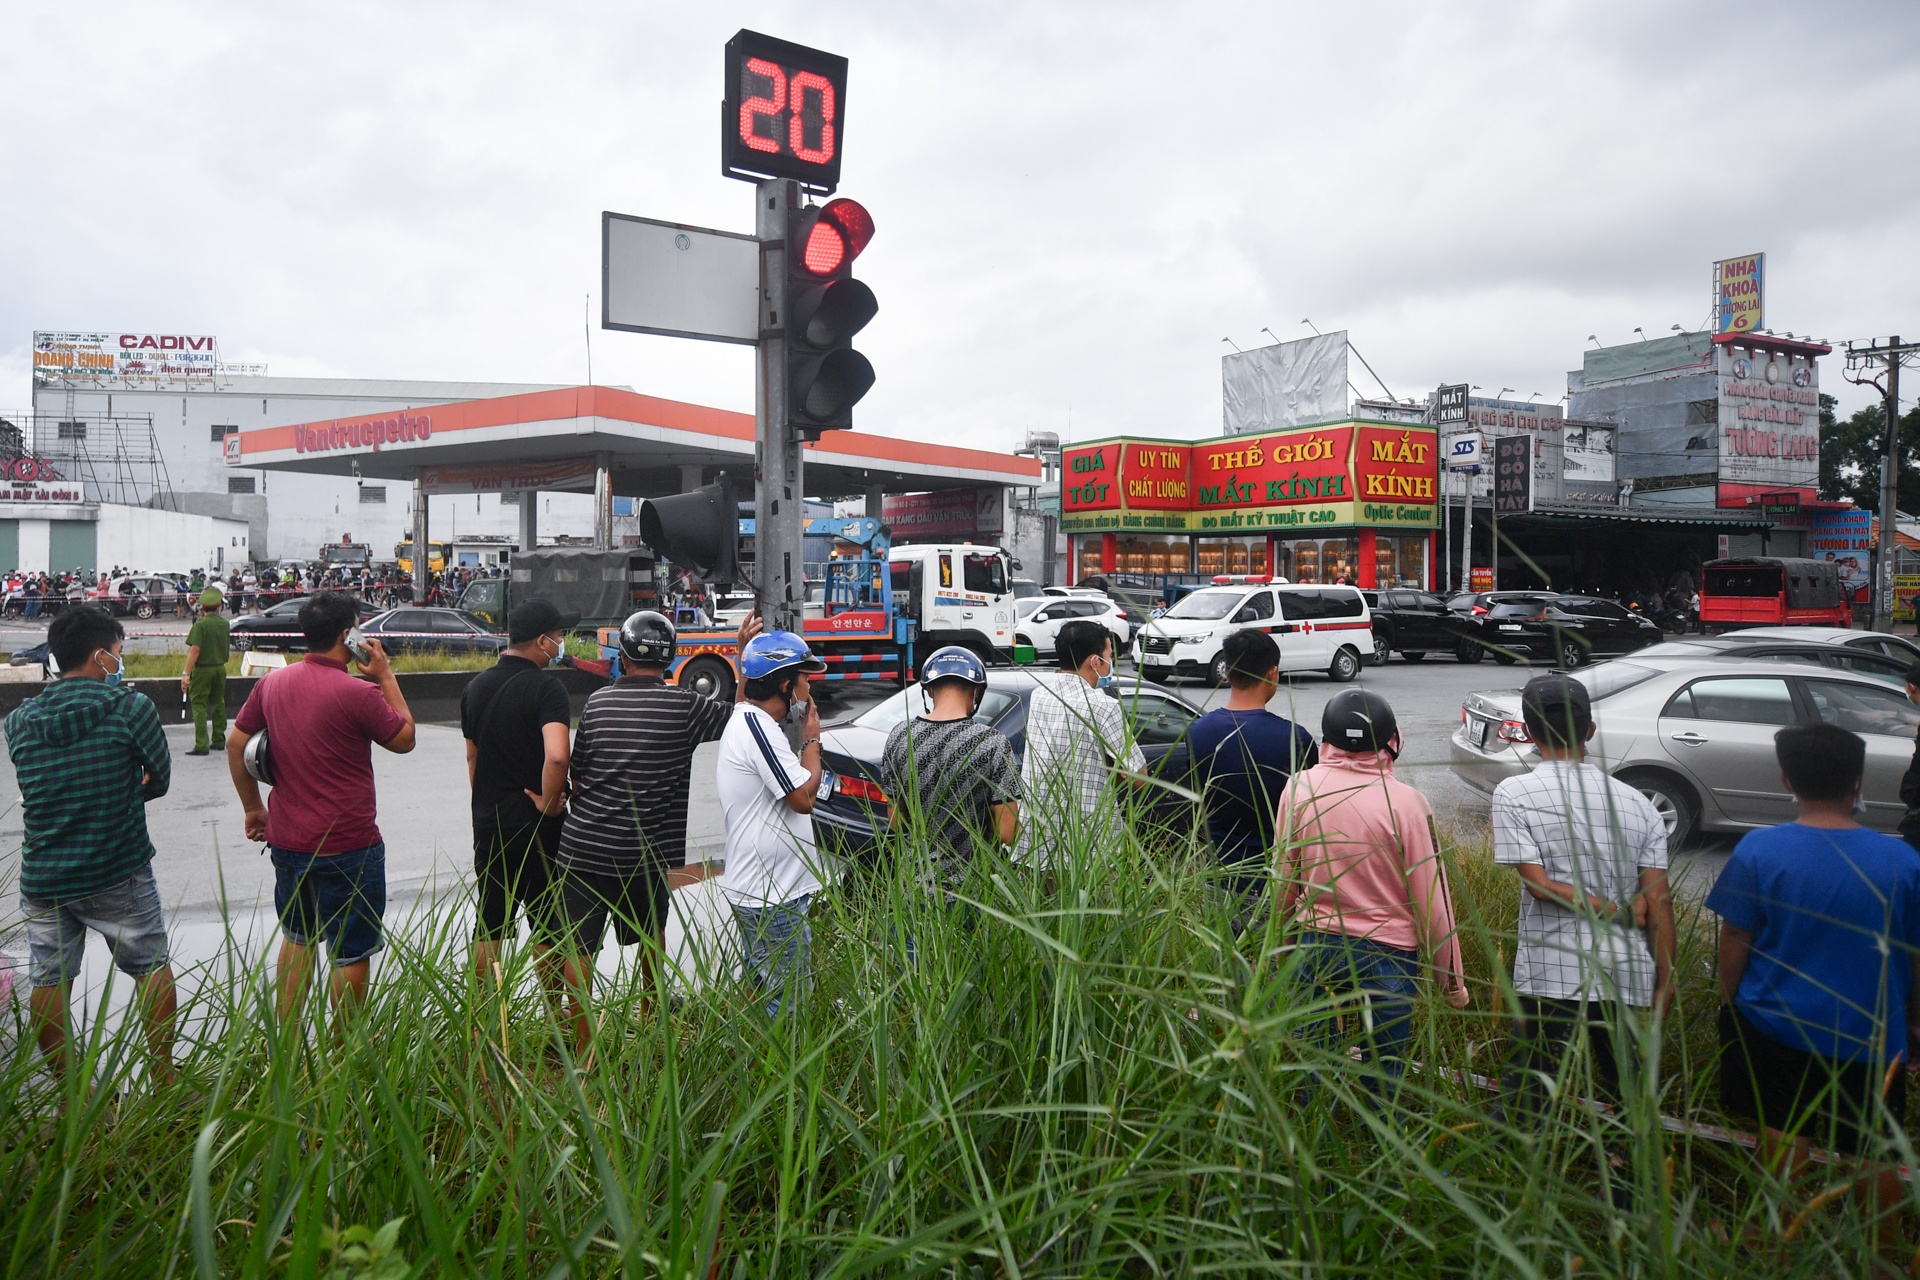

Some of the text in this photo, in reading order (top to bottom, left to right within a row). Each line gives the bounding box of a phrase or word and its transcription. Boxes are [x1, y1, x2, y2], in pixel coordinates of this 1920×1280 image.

[740, 57, 834, 164] 20
[1725, 259, 1757, 278] NHA
[1723, 279, 1758, 298] KHOA
[1749, 299, 1760, 310] LAI
[1733, 314, 1748, 328] 6
[119, 334, 213, 350] CADIVI
[34, 351, 74, 367] DOANH
[1442, 389, 1463, 405] MẮT
[1441, 405, 1464, 420] KÍNH
[294, 412, 432, 453] Vantrucpetro
[1208, 434, 1335, 470] THẾ GIỚI
[1372, 431, 1429, 464] MẮT
[1451, 440, 1476, 456] STS
[1072, 449, 1104, 473] GIÁ
[1139, 448, 1180, 469] UY TÍN
[1068, 477, 1109, 504] TỐT
[1129, 474, 1186, 501] CHẤT LƯỢNG
[1198, 471, 1346, 504] MẮT KÍNH
[1366, 468, 1433, 498] KÍNH
[1202, 517, 1217, 528] ĐO
[1221, 511, 1244, 527] MẮT
[1266, 509, 1305, 526] THUẬT
[1309, 510, 1336, 523] CAO
[1364, 503, 1432, 522] Optic Center
[1785, 505, 1796, 513] LAI
[1852, 538, 1870, 550] LAI
